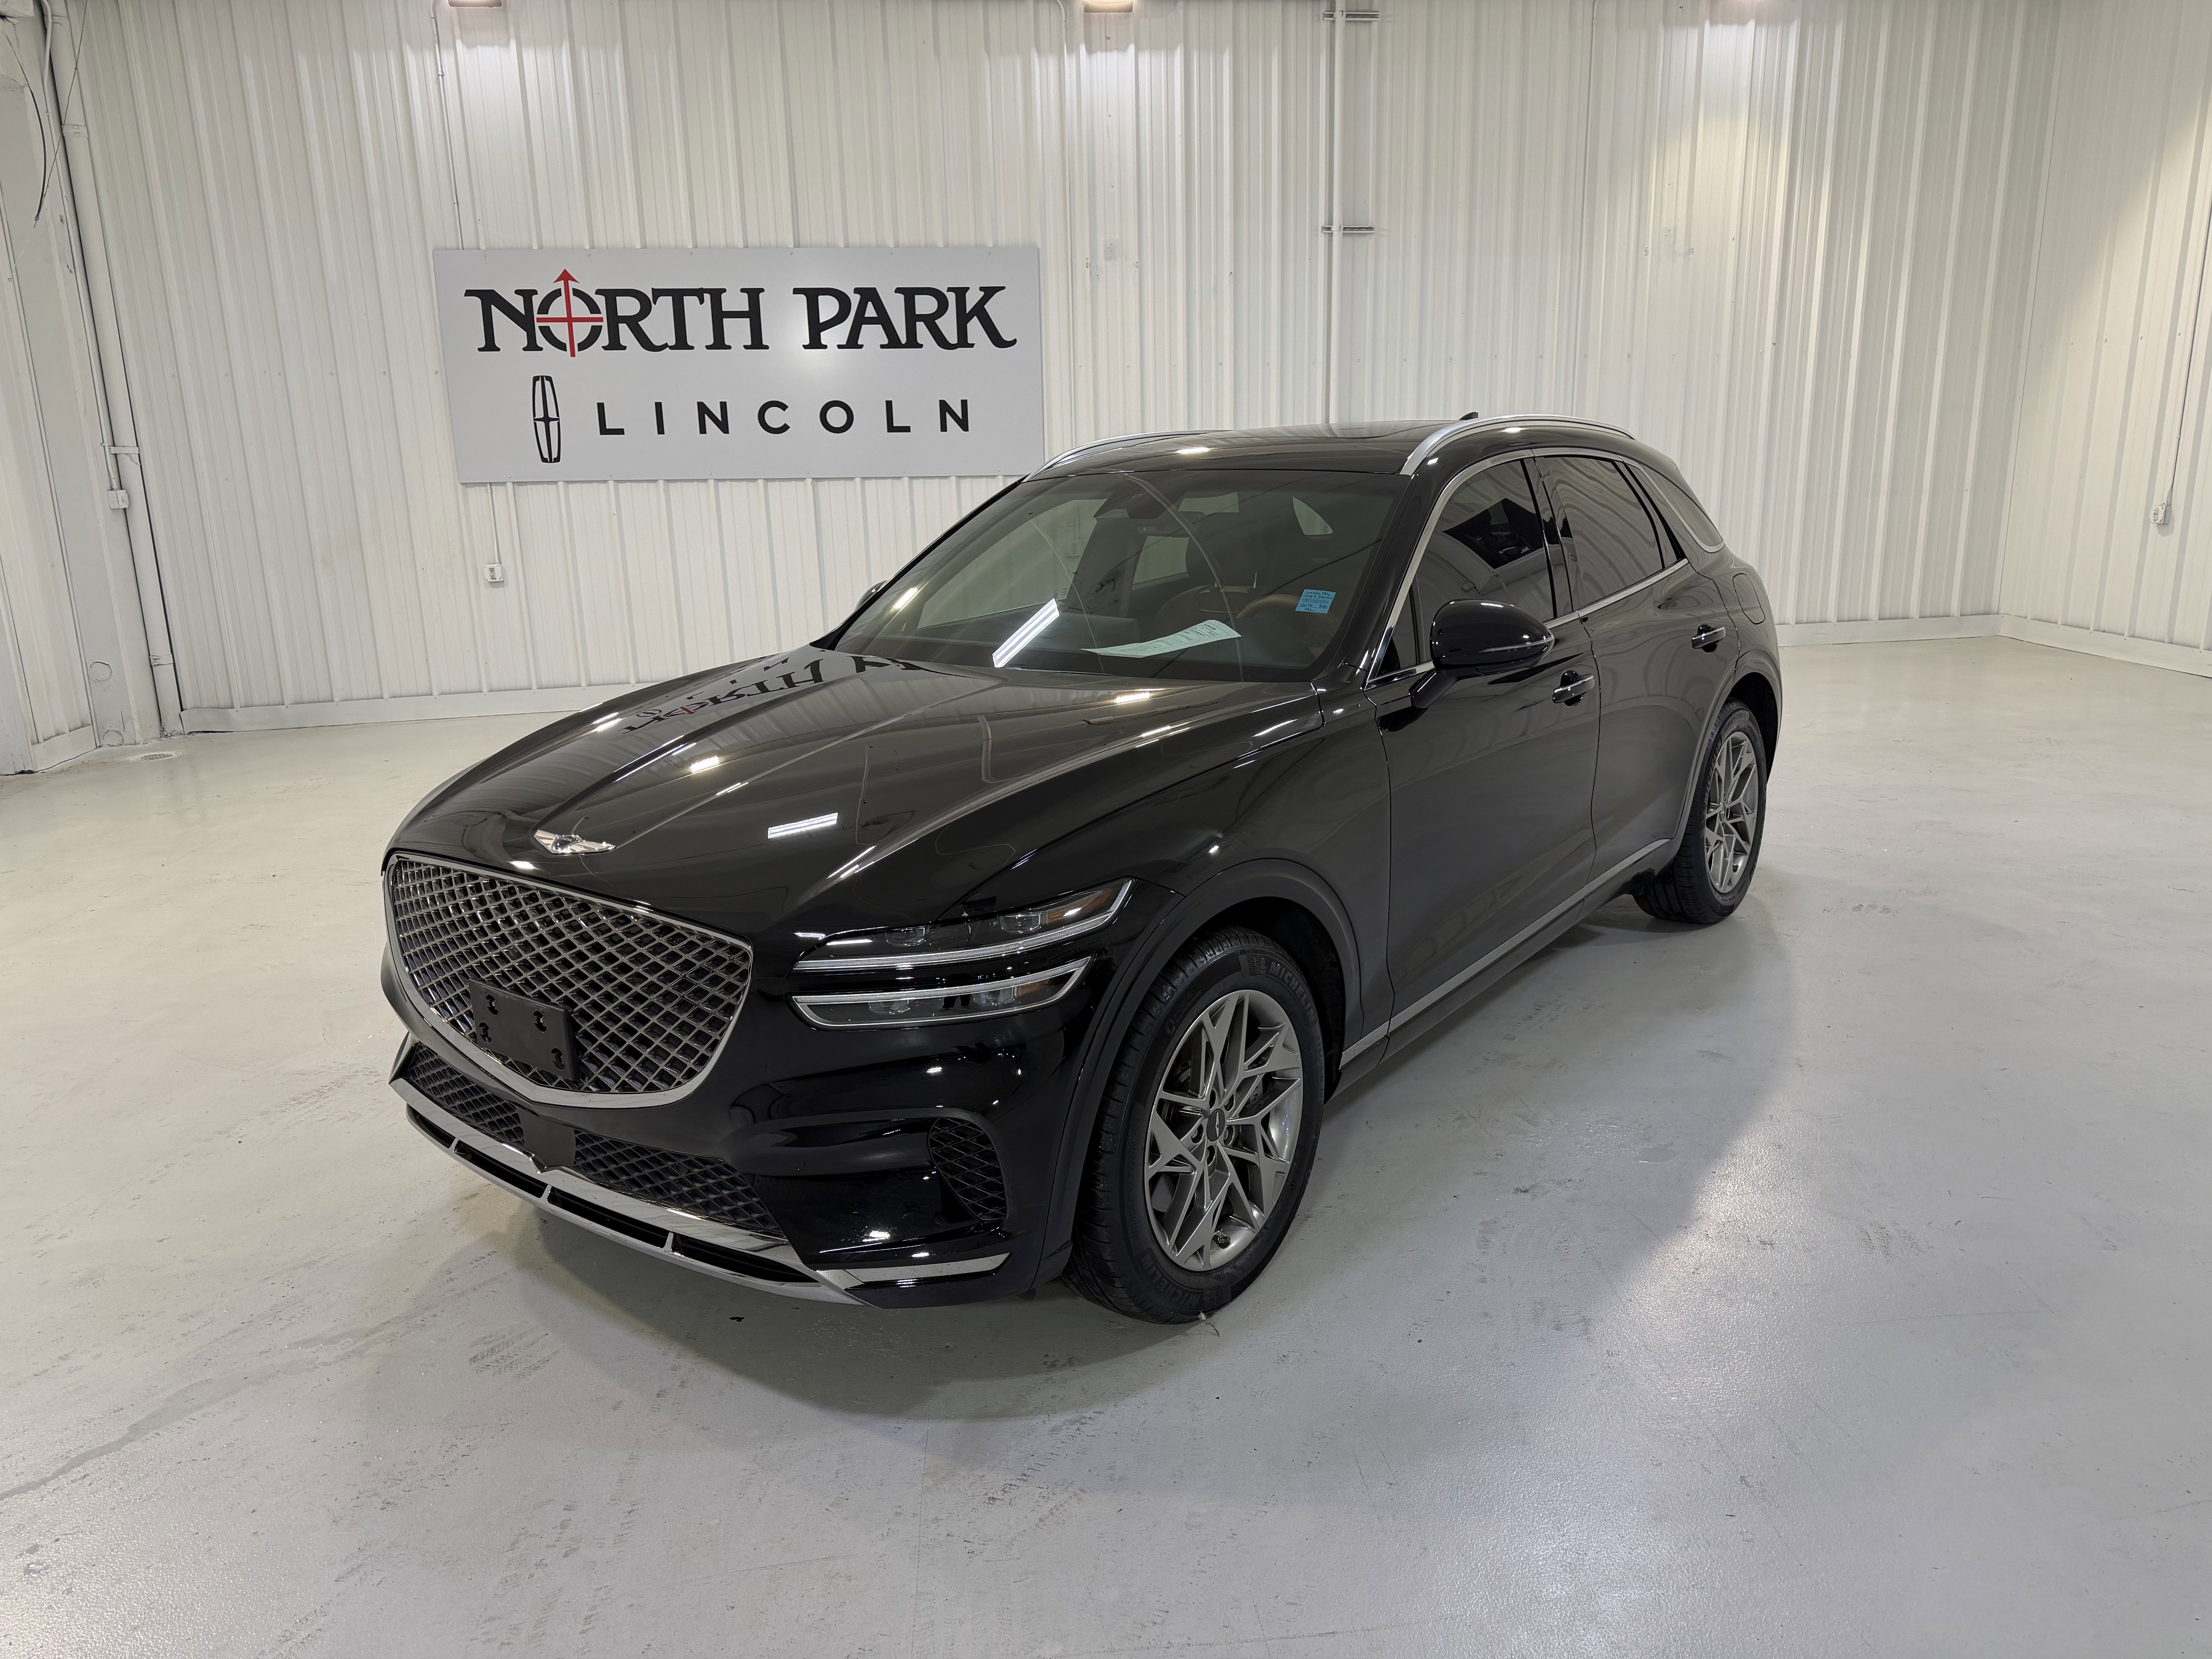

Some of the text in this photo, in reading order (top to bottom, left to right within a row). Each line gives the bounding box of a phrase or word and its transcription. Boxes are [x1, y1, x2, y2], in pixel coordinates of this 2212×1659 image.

[464, 286, 1017, 352] NORTH PARK
[597, 399, 969, 435] LINCOLN
[1269, 962, 1317, 1023] MICHELIN
[1128, 1141, 1137, 1177] TOUR
[1128, 1186, 1139, 1241] PRIMACY
[1141, 1253, 1201, 1310] MICHELIN
